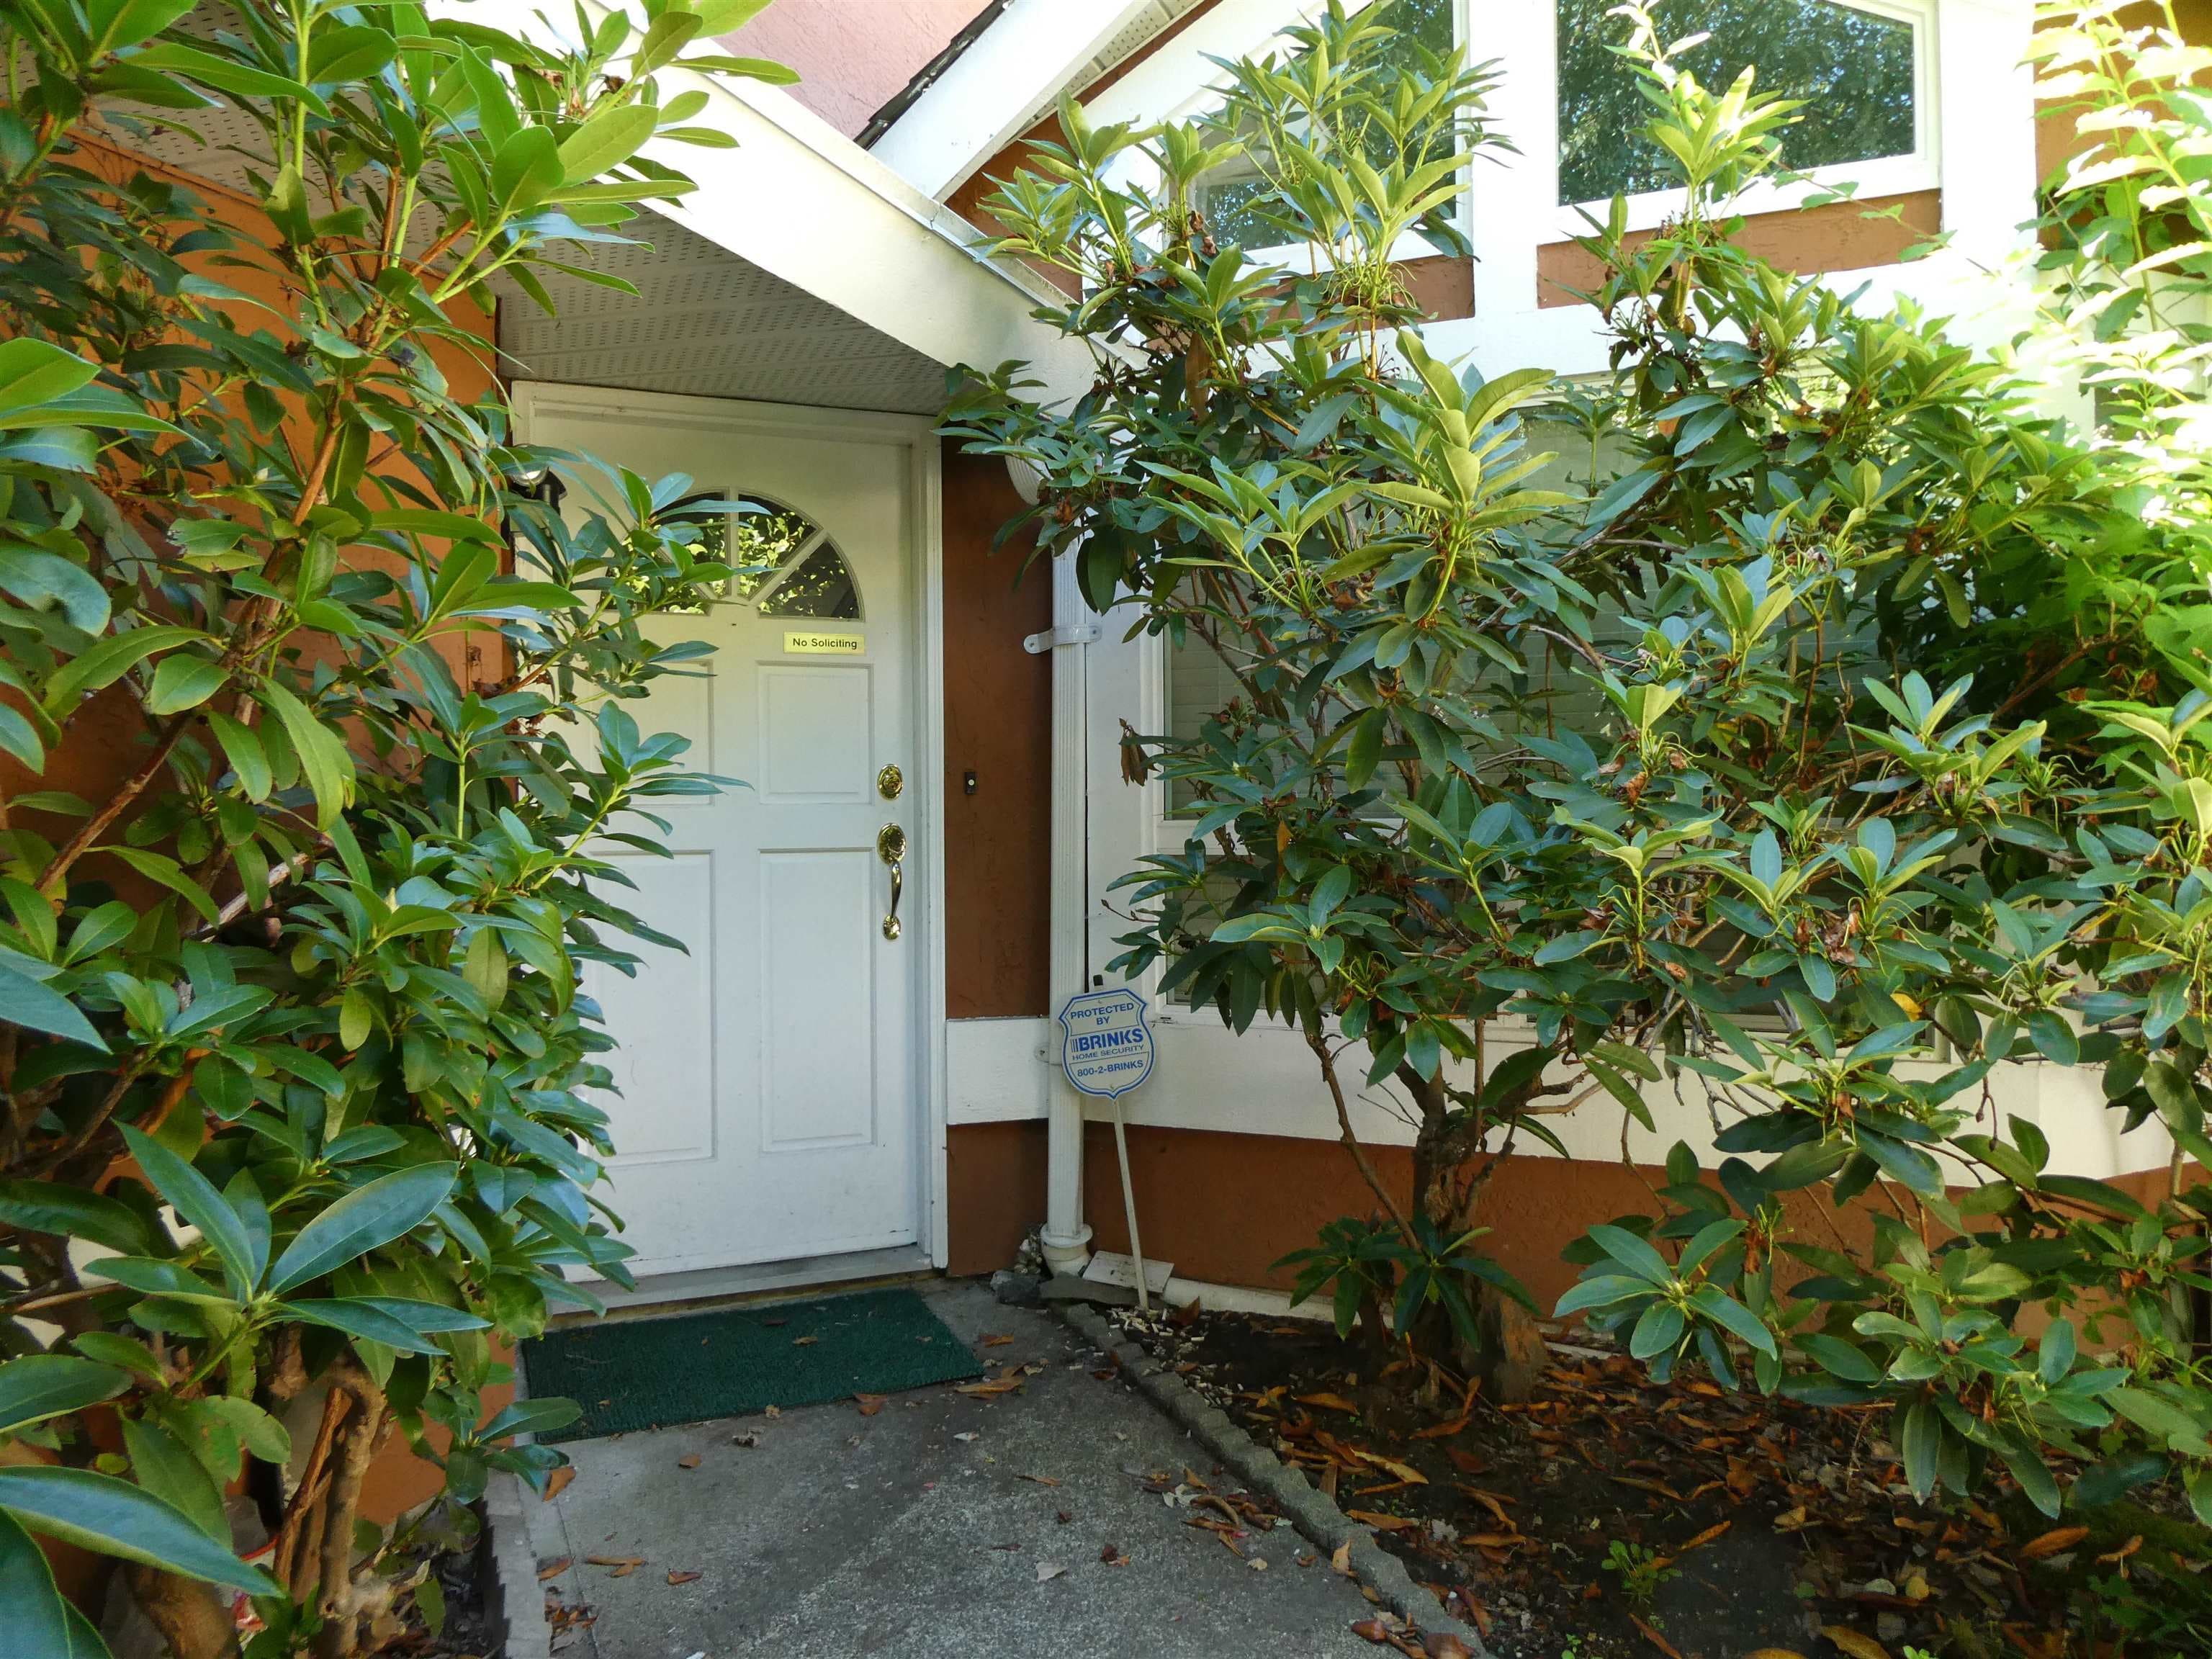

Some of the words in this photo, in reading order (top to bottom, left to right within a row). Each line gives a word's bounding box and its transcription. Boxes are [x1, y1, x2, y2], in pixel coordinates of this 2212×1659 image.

[793, 638, 807, 647] No
[811, 639, 858, 650] Soliciting
[1071, 1002, 1134, 1020] PROTECTED
[1097, 1016, 1110, 1025] BY
[1079, 1028, 1143, 1051] BRINKS
[1072, 1052, 1098, 1061] HOME
[1101, 1045, 1144, 1056] SECURITY
[1077, 1060, 1143, 1077] 800-2-BRINKS
